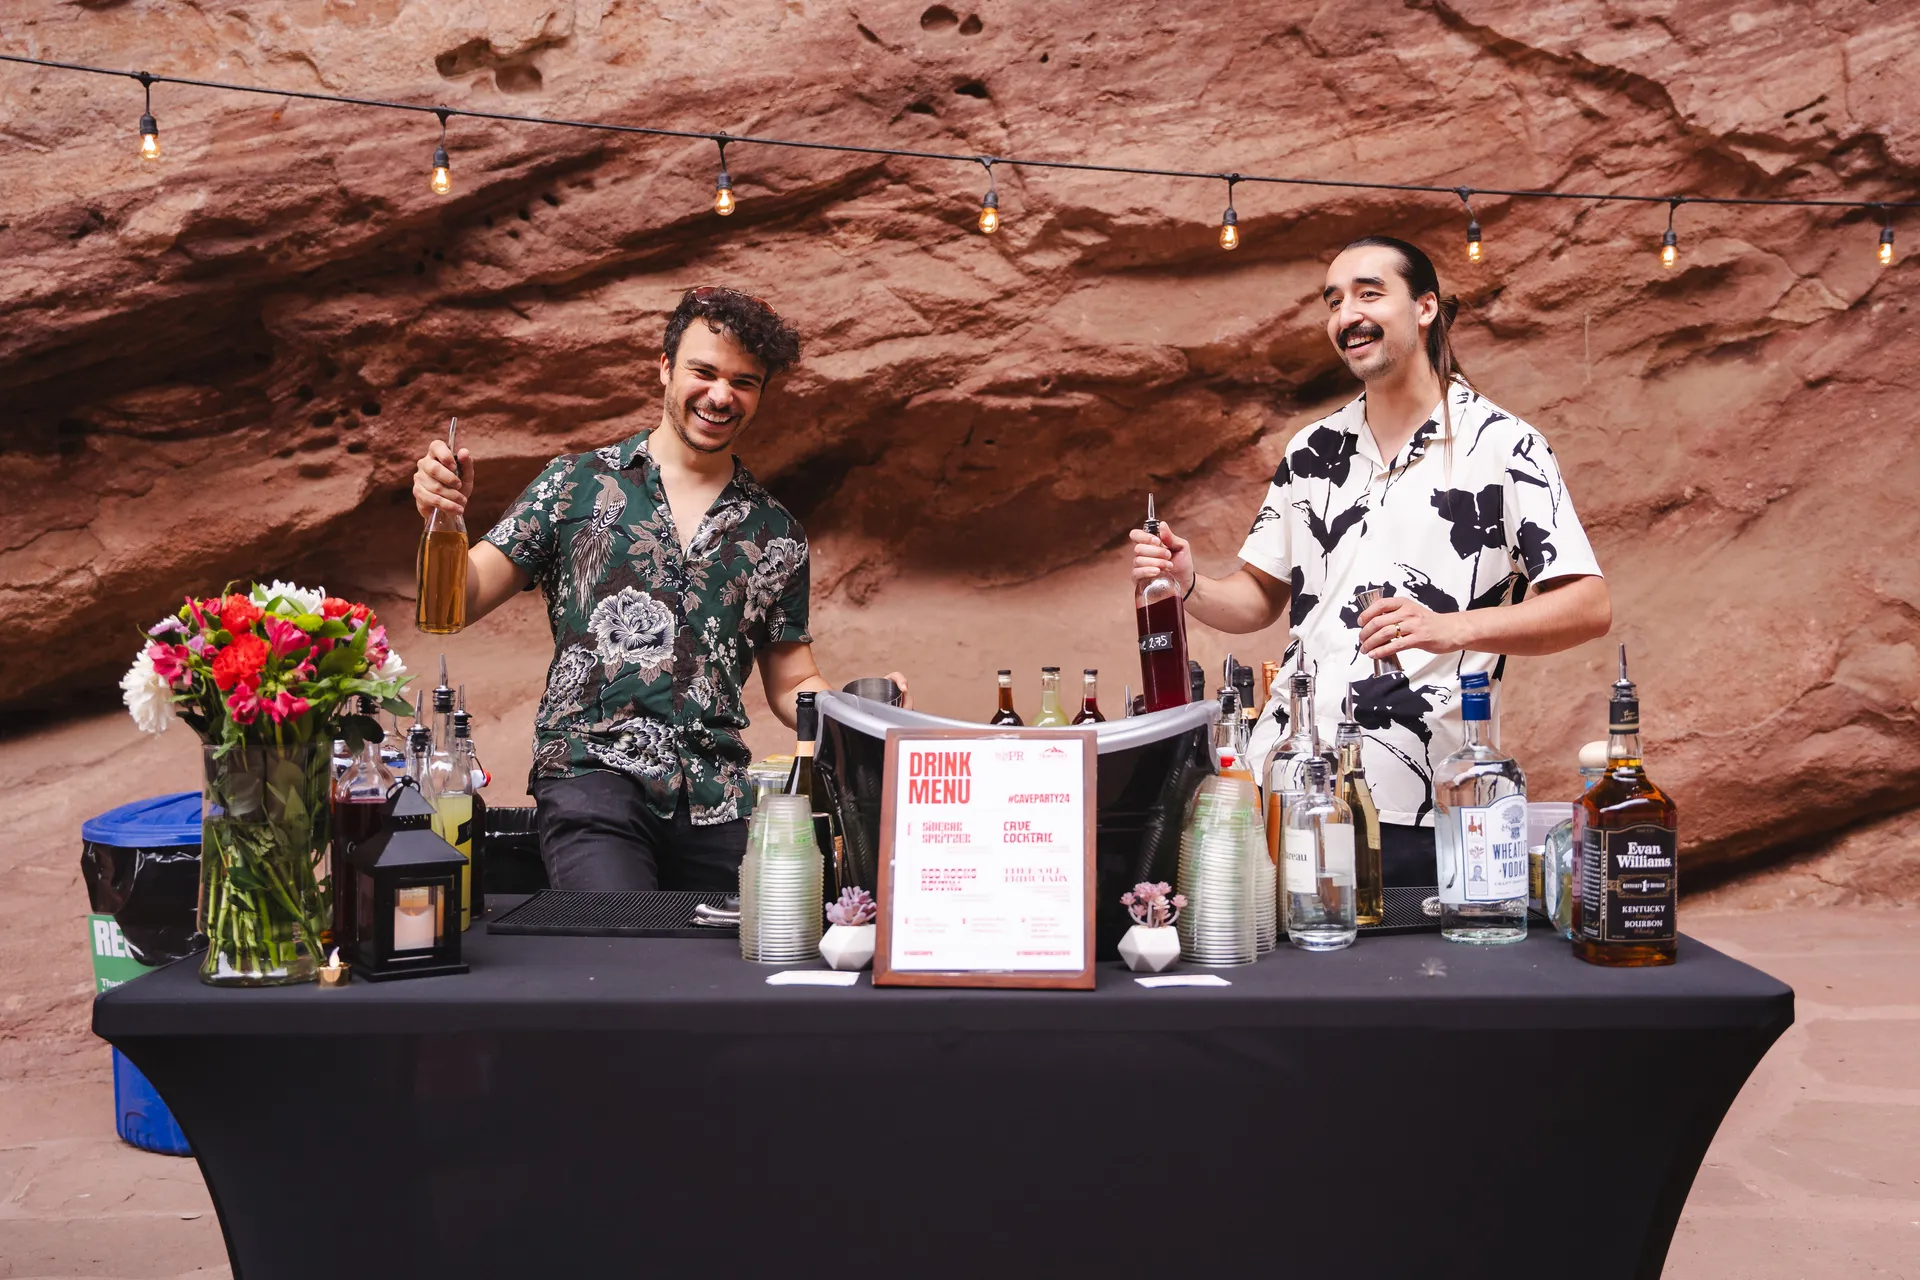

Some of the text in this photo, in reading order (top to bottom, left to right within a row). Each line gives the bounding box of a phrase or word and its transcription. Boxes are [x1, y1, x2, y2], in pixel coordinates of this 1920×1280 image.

[909, 752, 972, 777] DRINK
[908, 779, 971, 804] MENU
[1008, 793, 1070, 804] #CAVEPARTY24
[1003, 821, 1031, 831] CAVE
[1003, 832, 1053, 843] COCKTAIL
[1627, 842, 1661, 854] Evan
[1616, 855, 1671, 867] Williams
[1622, 905, 1665, 913] KENTUCKY
[1624, 919, 1663, 928] BOURBON
